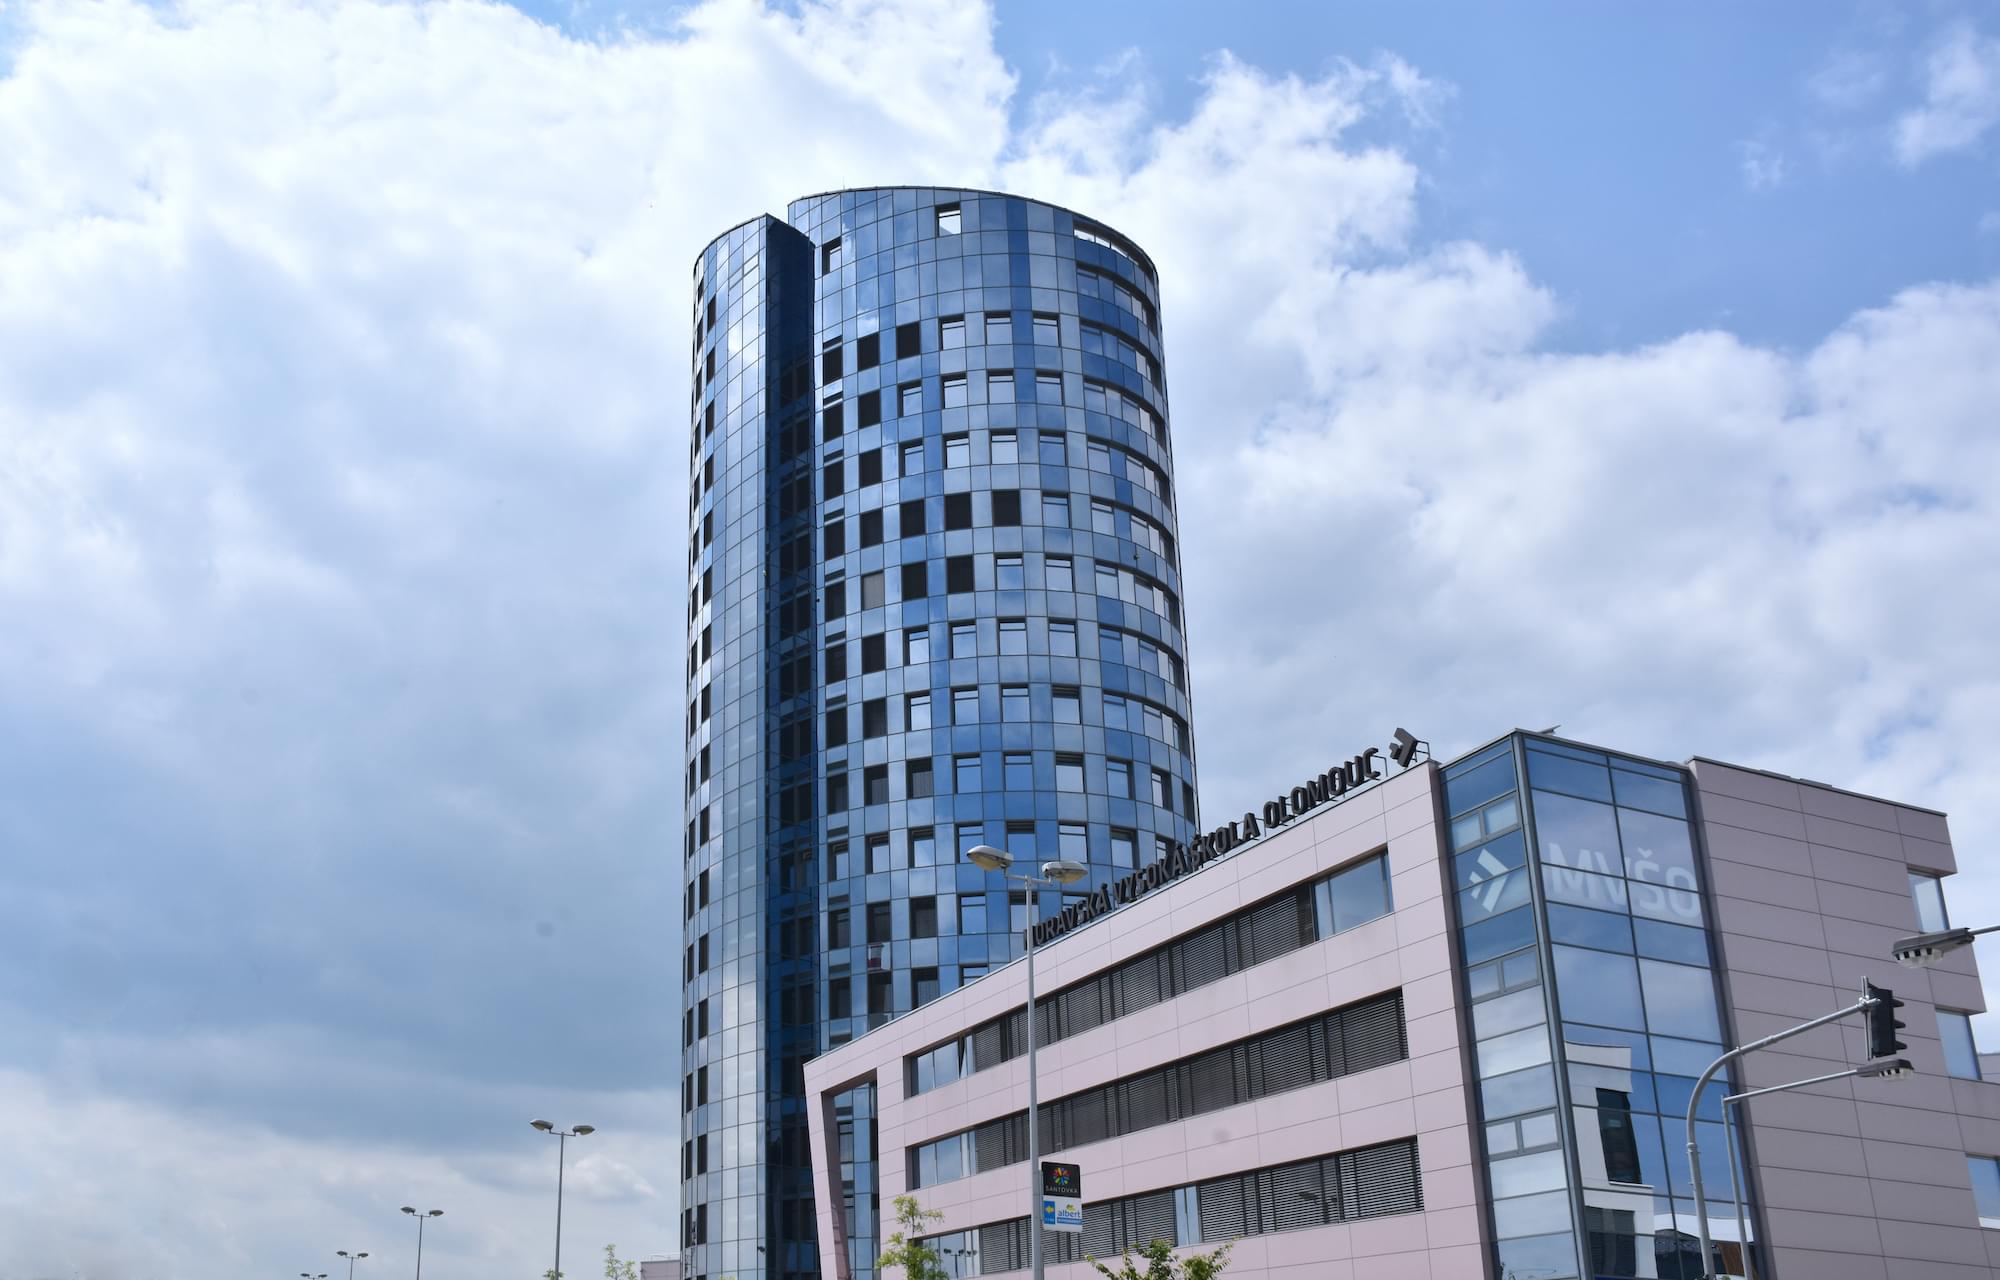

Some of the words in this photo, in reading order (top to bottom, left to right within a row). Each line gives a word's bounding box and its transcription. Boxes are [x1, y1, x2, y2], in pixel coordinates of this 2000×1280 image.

[1114, 842, 1186, 900] VYSOKÁ
[1190, 812, 1260, 870] ŠKOLA
[1263, 747, 1381, 828] OLOMOUC
[1549, 842, 1700, 918] MVŠO
[1058, 1209, 1081, 1217] albert
